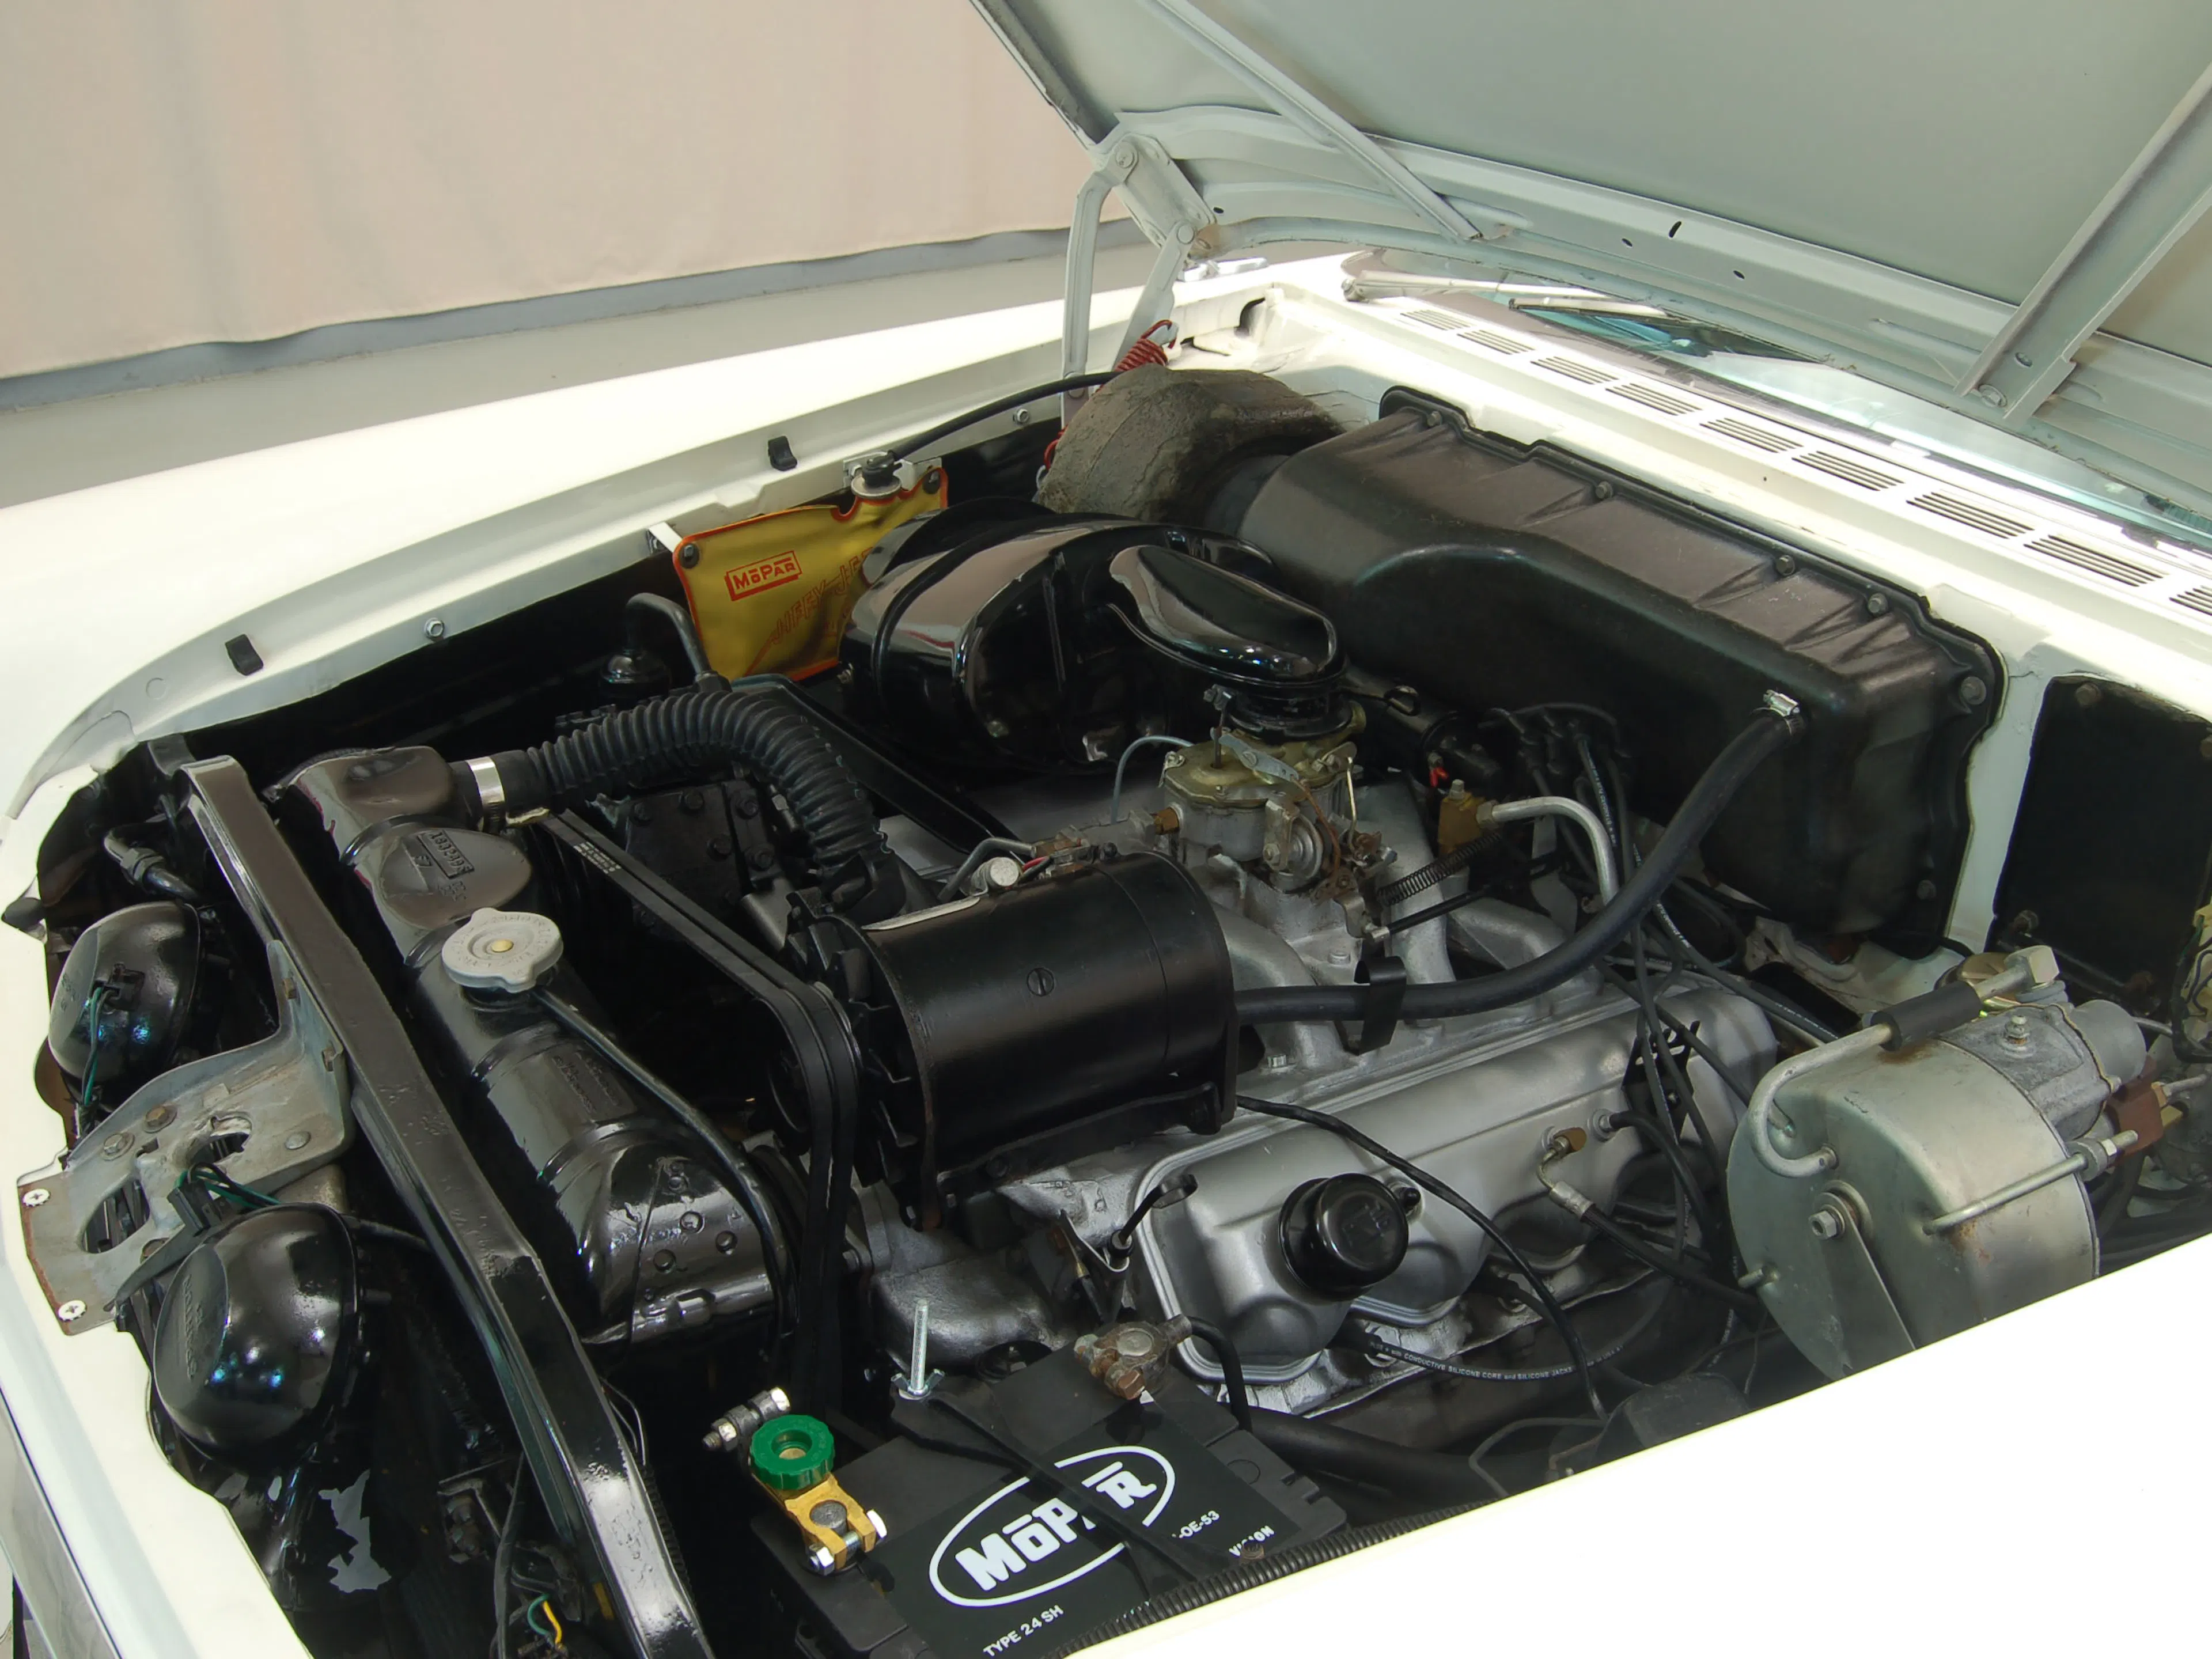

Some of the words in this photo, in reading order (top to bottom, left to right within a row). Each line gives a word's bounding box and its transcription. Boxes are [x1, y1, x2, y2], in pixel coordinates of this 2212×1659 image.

[1448, 1365, 1480, 1378] SILICONE
[955, 1461, 1157, 1592] MOPR
[983, 1630, 1022, 1657] TYPE
[1020, 1617, 1043, 1636] 24
[1040, 1604, 1065, 1623] SH
